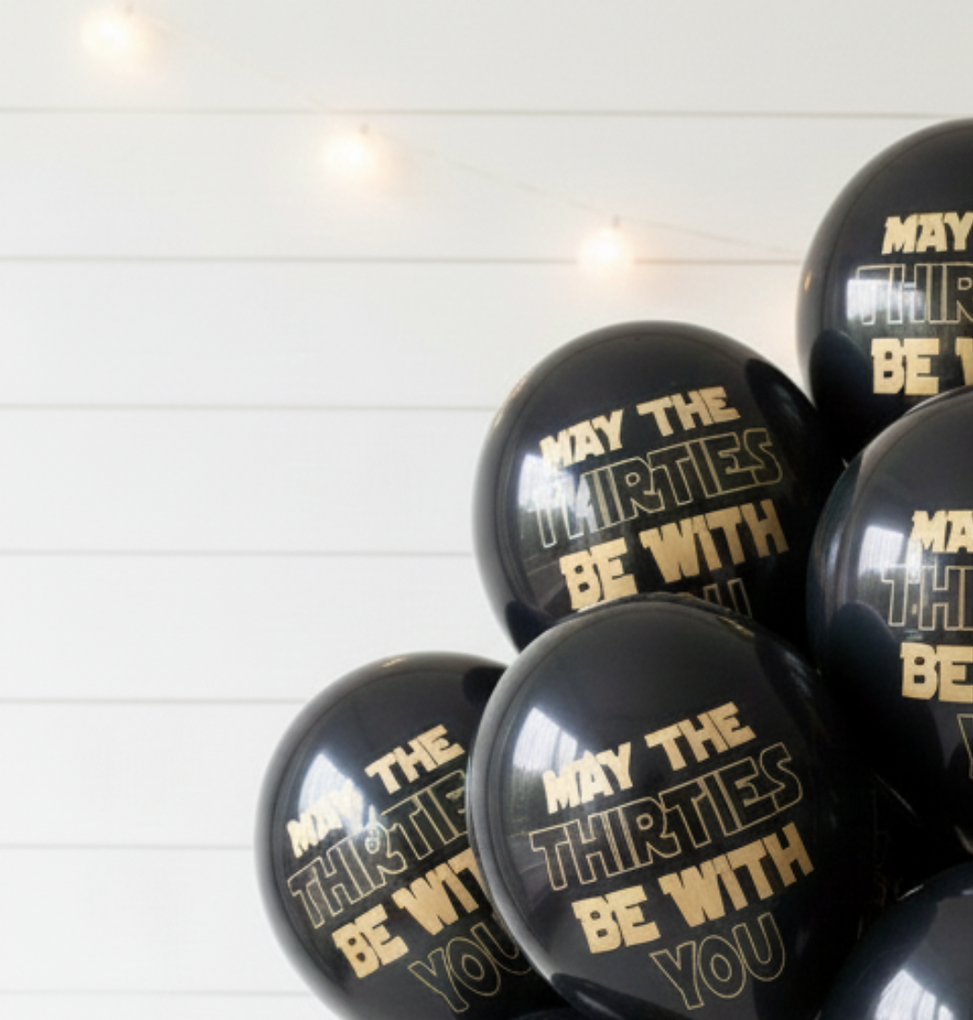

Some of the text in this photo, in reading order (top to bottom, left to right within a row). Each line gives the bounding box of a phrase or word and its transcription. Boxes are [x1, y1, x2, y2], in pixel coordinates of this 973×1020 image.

[871, 338, 939, 396] BE
[539, 386, 741, 471] MAY THE
[559, 538, 638, 610] BE
[639, 499, 789, 584] WITH
[287, 723, 465, 858] MAY THE
[542, 701, 757, 814] MAY THE
[529, 742, 803, 891] THIRTIES
[571, 821, 814, 954] BE WITH
[332, 903, 409, 979] BE
[408, 922, 532, 1013] YOU
[650, 912, 785, 1010] YOU
